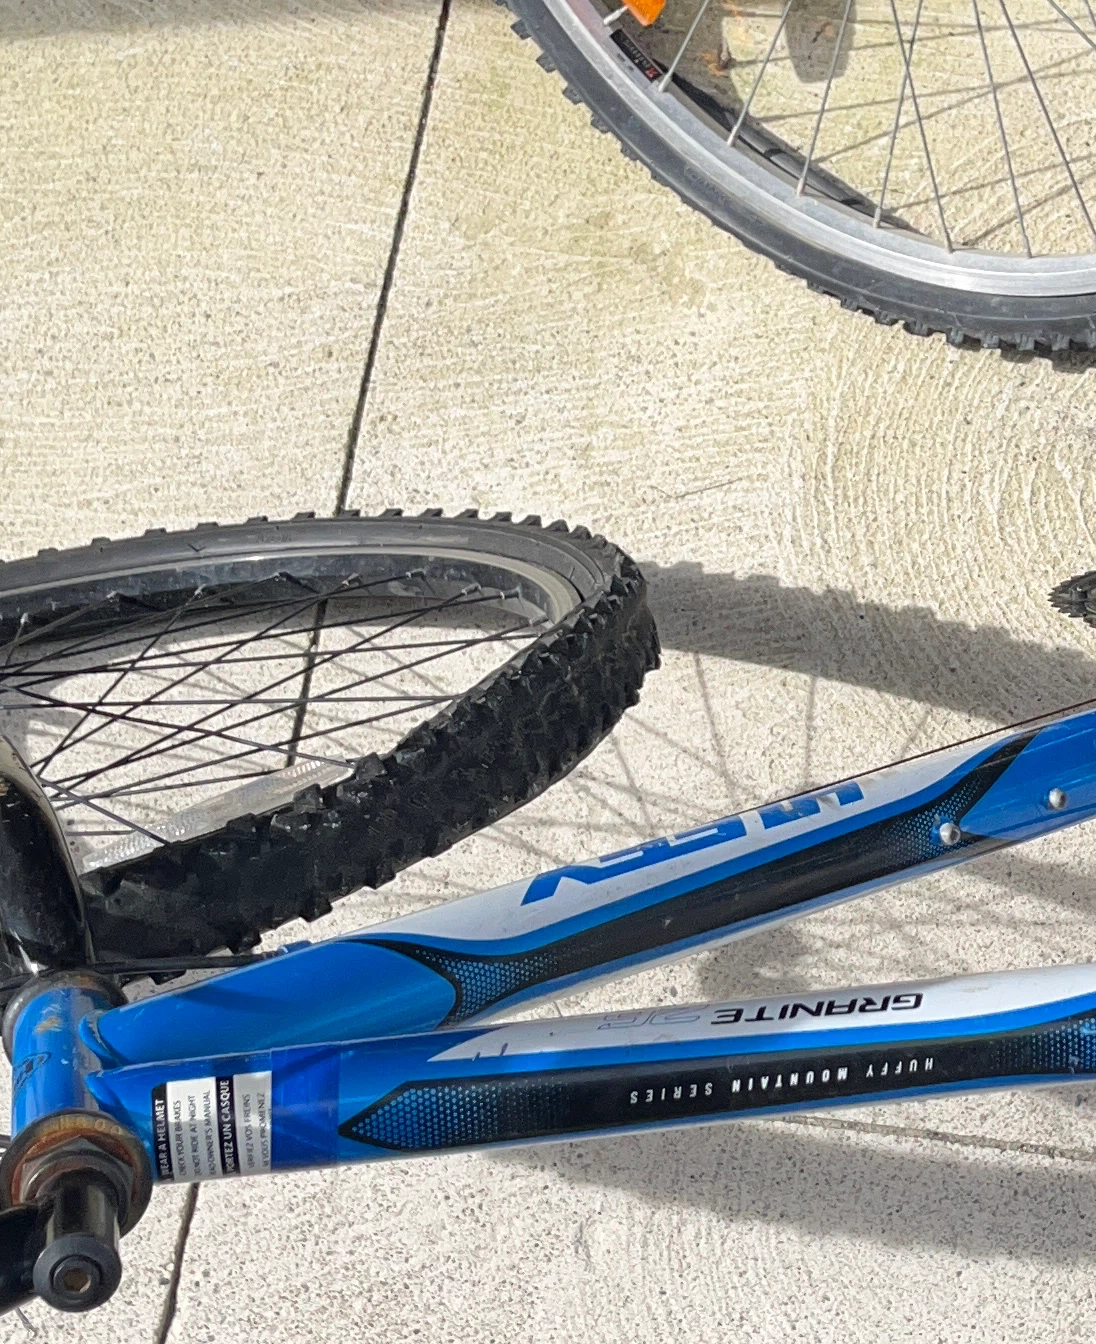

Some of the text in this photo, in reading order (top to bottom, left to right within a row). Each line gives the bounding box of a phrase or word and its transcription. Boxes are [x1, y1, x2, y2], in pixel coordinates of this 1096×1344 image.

[710, 992, 924, 1025] GRANITE
[629, 1057, 934, 1105] HUFFY MOUNTAIN SERIES
[155, 1099, 167, 1142] HELMET
[173, 1100, 183, 1131] BRAKES
[188, 1095, 197, 1121] NIGHT
[203, 1090, 212, 1126] MANUAL
[242, 1094, 252, 1122] FREINS
[257, 1093, 268, 1138] PROMENEZ
[220, 1080, 235, 1173] PORTEZ UN CASQUE
[244, 1124, 253, 1141] VOS
[158, 1145, 168, 1155] A
[175, 1133, 185, 1156] YOUR
[190, 1135, 199, 1153] RIDE
